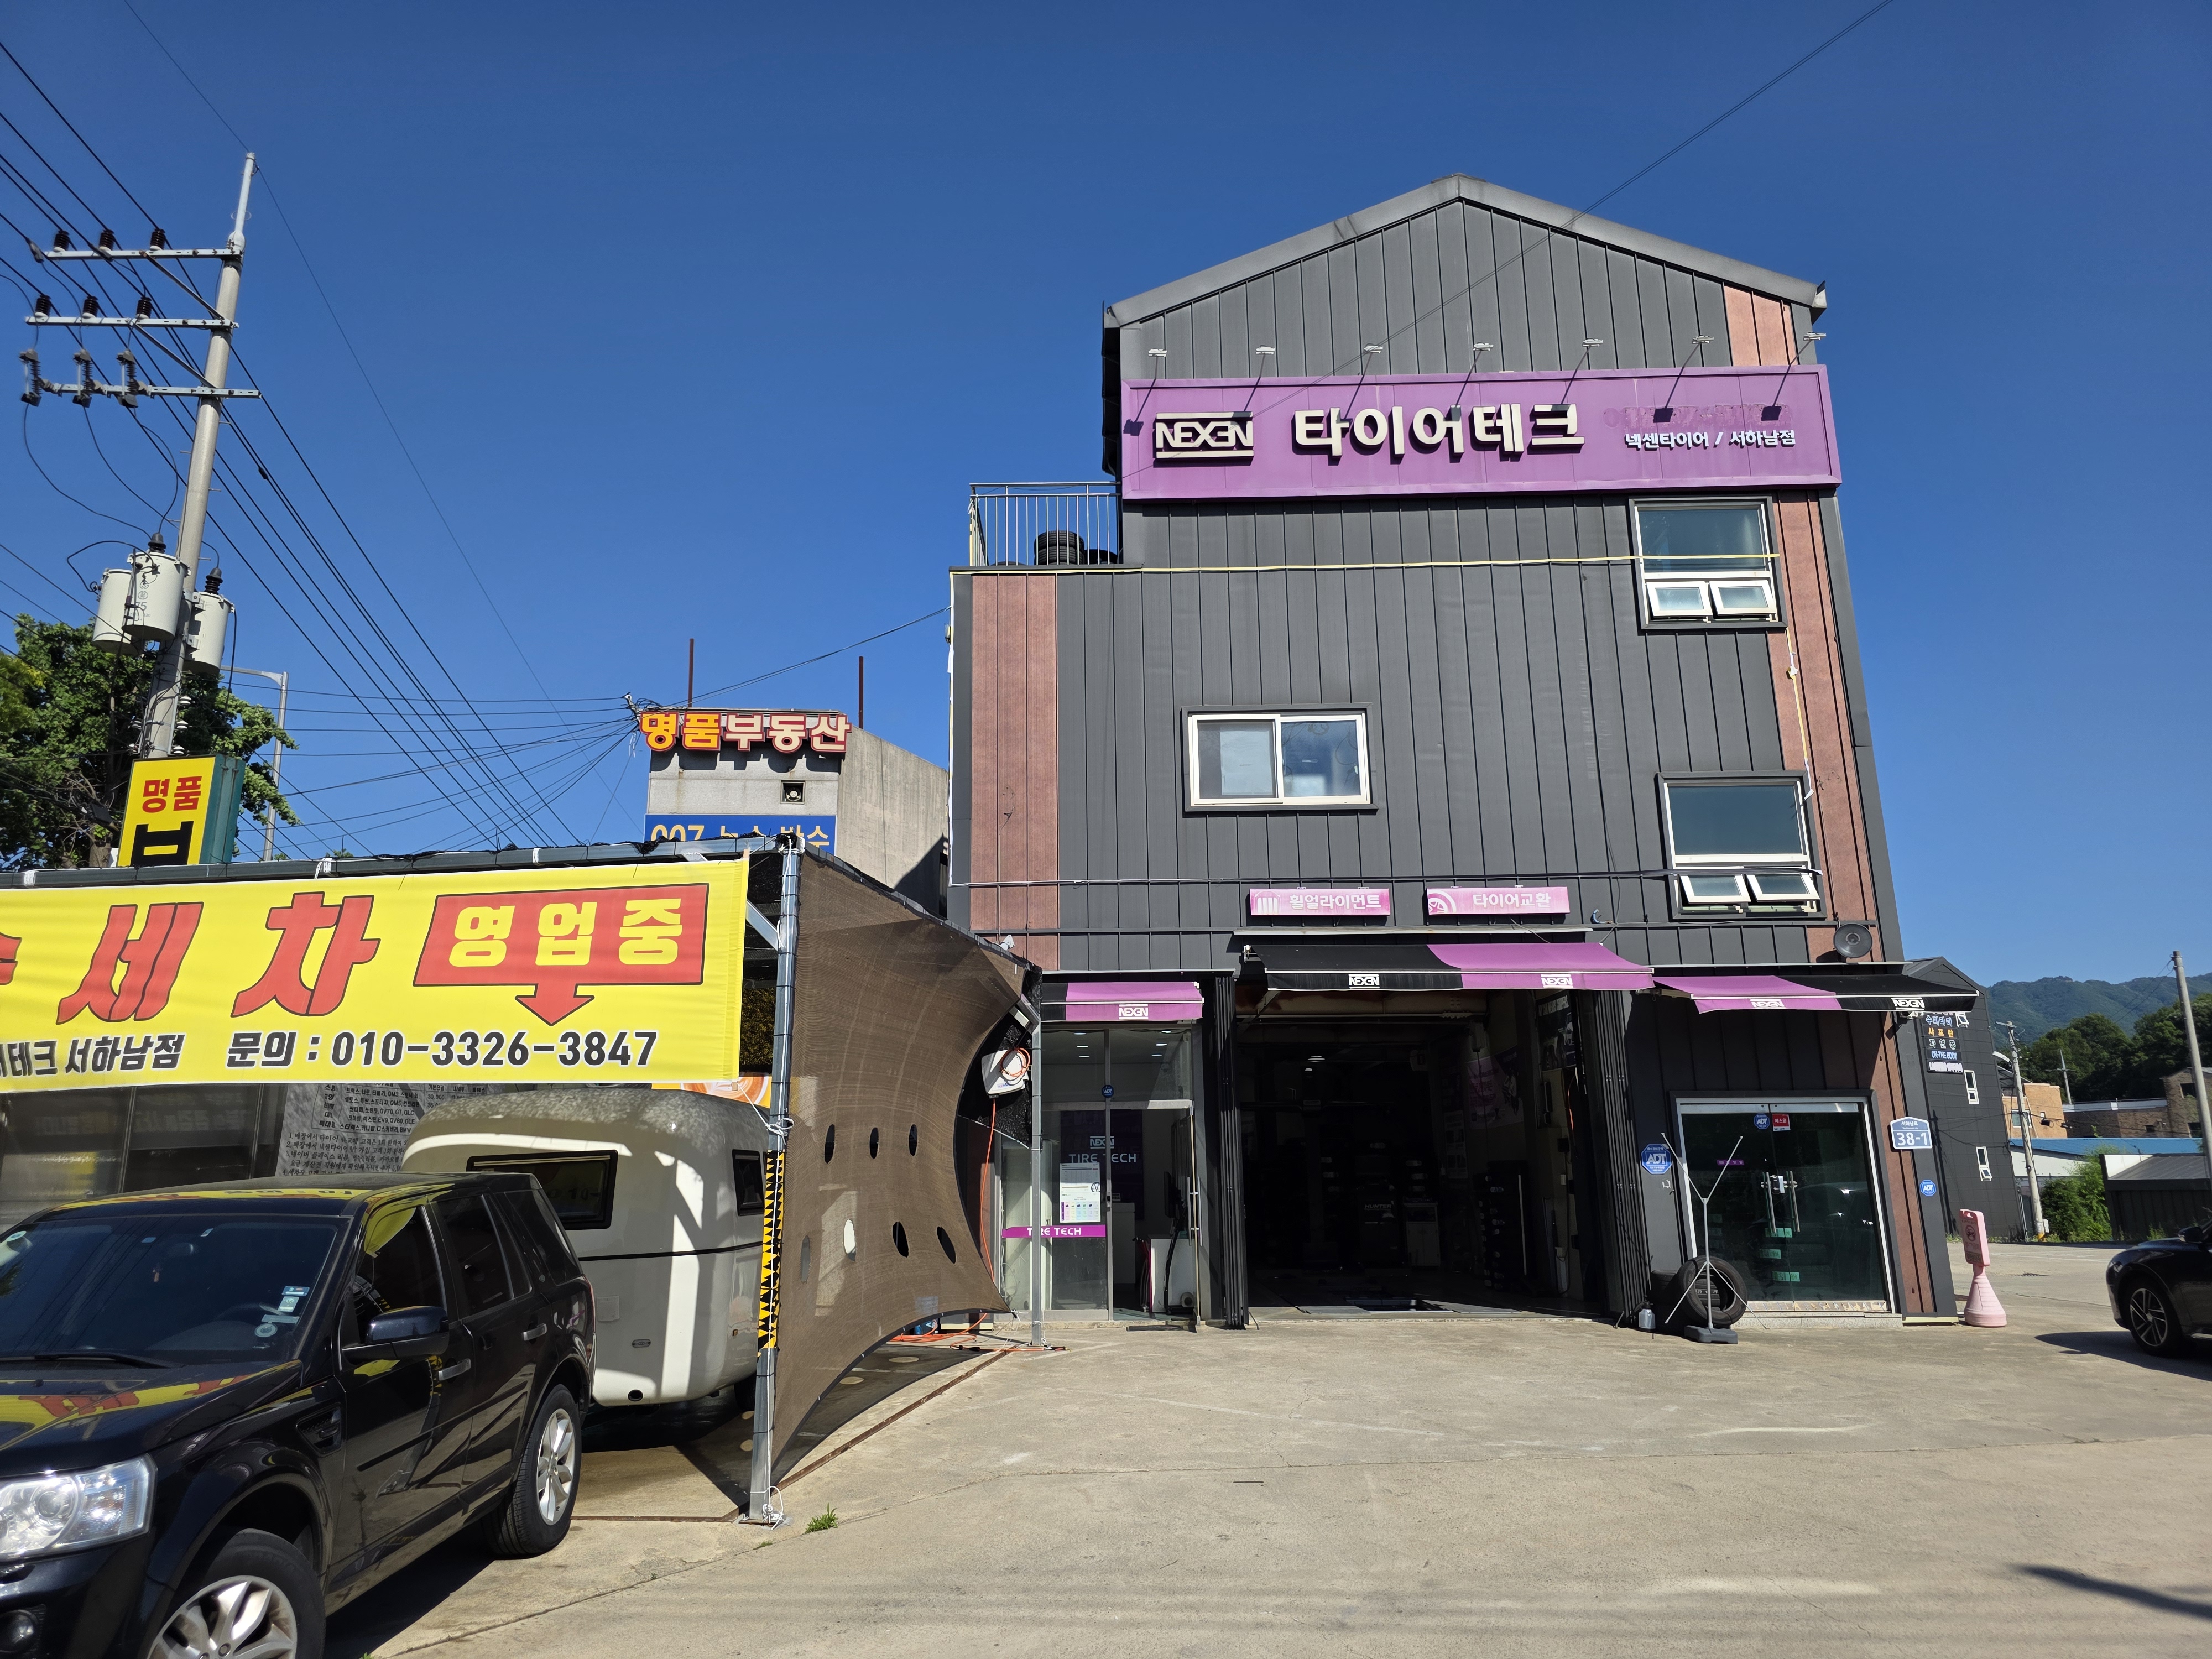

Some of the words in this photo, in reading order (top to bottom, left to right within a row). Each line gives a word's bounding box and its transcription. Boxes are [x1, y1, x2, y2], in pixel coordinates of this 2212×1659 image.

[1156, 420, 1254, 448] NEXEN
[1295, 401, 1584, 456] 타이어테크
[1625, 431, 1709, 449] 넥센타이어
[1730, 430, 1796, 447] 서하남점
[639, 712, 852, 753] 명품부동산
[142, 776, 202, 813] 명품
[1289, 894, 1381, 910] 휠얼라이먼트
[1473, 893, 1552, 908] 타이어교환
[448, 898, 682, 967] 영업중
[1349, 977, 1380, 986] NEXEN
[1541, 977, 1573, 986] NEXEN
[1893, 999, 1925, 1008] NEXEN
[1119, 1006, 1149, 1018] NEXEN
[1926, 1015, 1953, 1027] 수퍼타이
[65, 1034, 185, 1074] 서하남점
[226, 1032, 296, 1067] 문의
[332, 1031, 657, 1066] 010-3326-3847
[320, 1134, 338, 1142] 타이어
[1897, 1132, 1928, 1146] 38-1
[320, 1143, 348, 1152] 넥센타이어
[1068, 1154, 1098, 1163] TIRE
[1103, 1153, 1136, 1163] ECH
[1647, 1153, 1667, 1164] ADT
[1027, 1228, 1050, 1236] TRE
[1053, 1227, 1081, 1236] TECH
